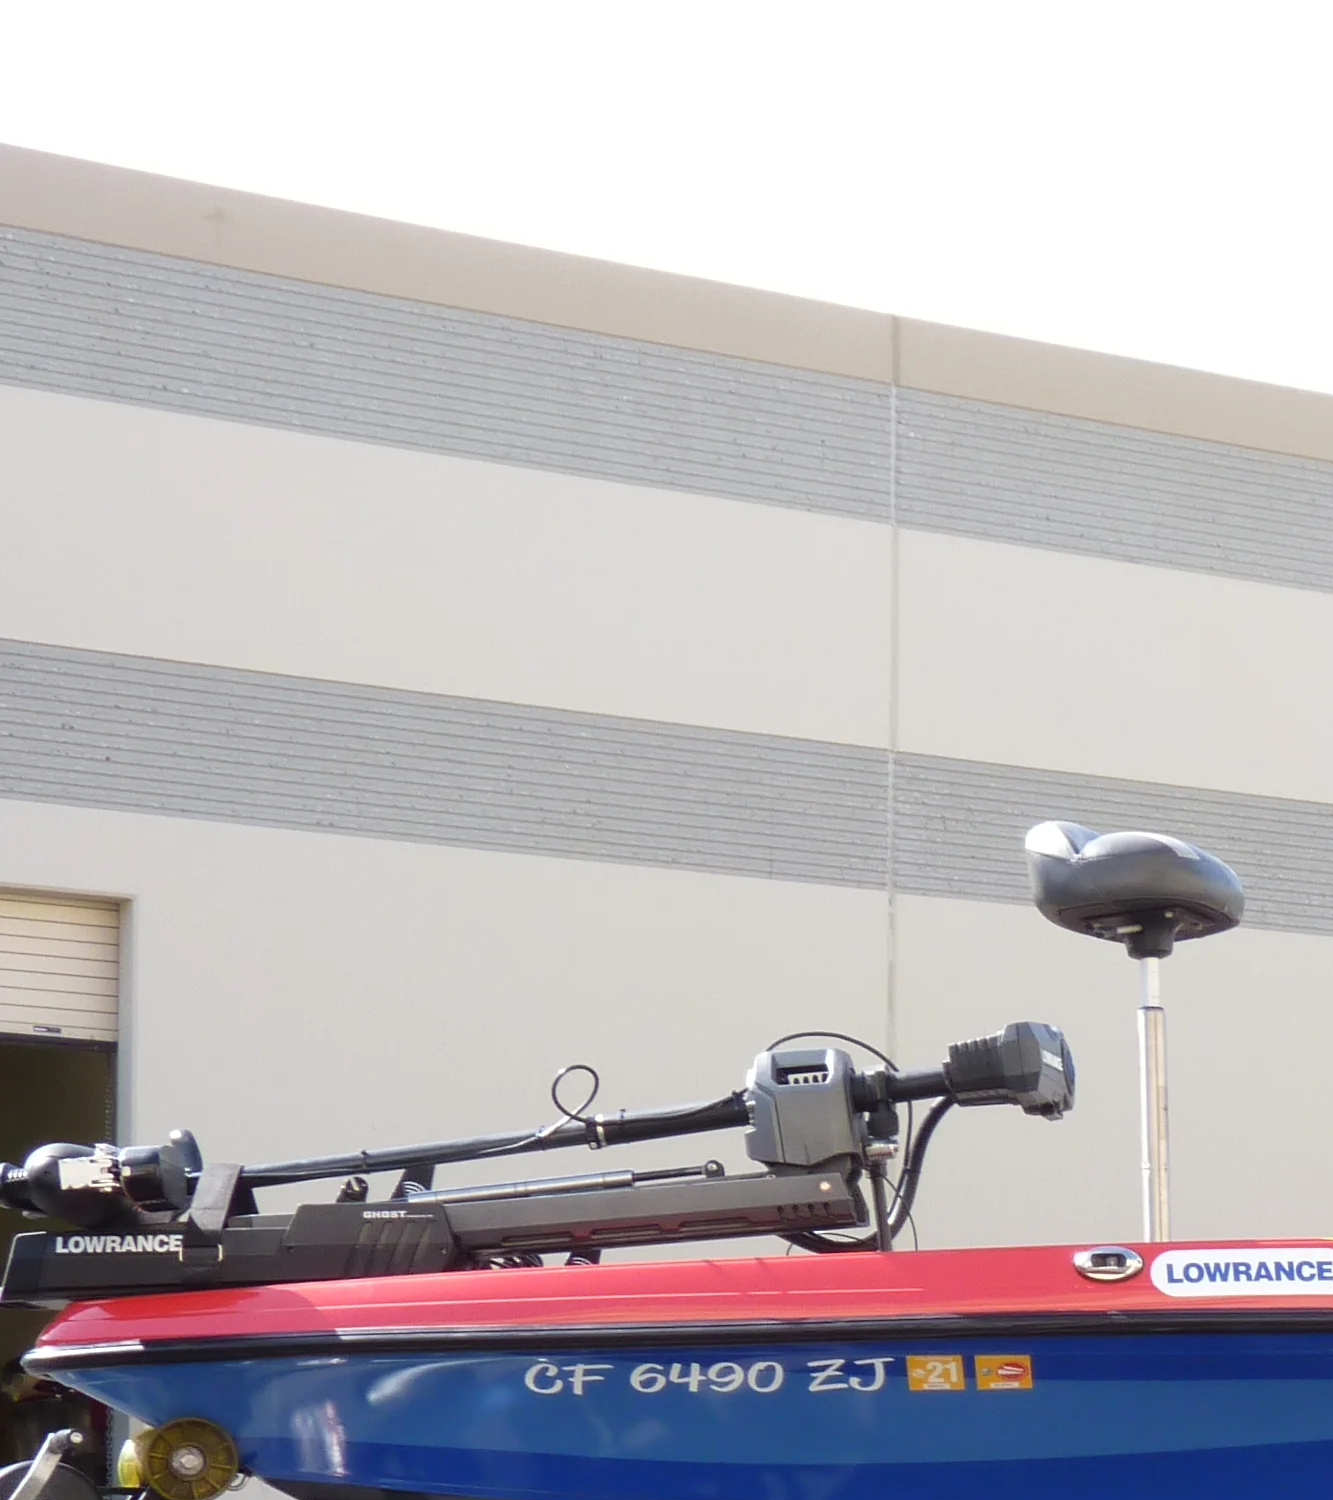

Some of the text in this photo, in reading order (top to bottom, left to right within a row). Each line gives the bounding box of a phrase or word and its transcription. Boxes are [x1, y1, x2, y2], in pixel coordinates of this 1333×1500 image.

[363, 1210, 407, 1219] GHOST
[55, 1234, 183, 1253] LOWRANCE
[1166, 1260, 1333, 1284] LOWRANCE
[524, 1357, 895, 1395] CF 6490 ZJ
[926, 1361, 958, 1383] 21
